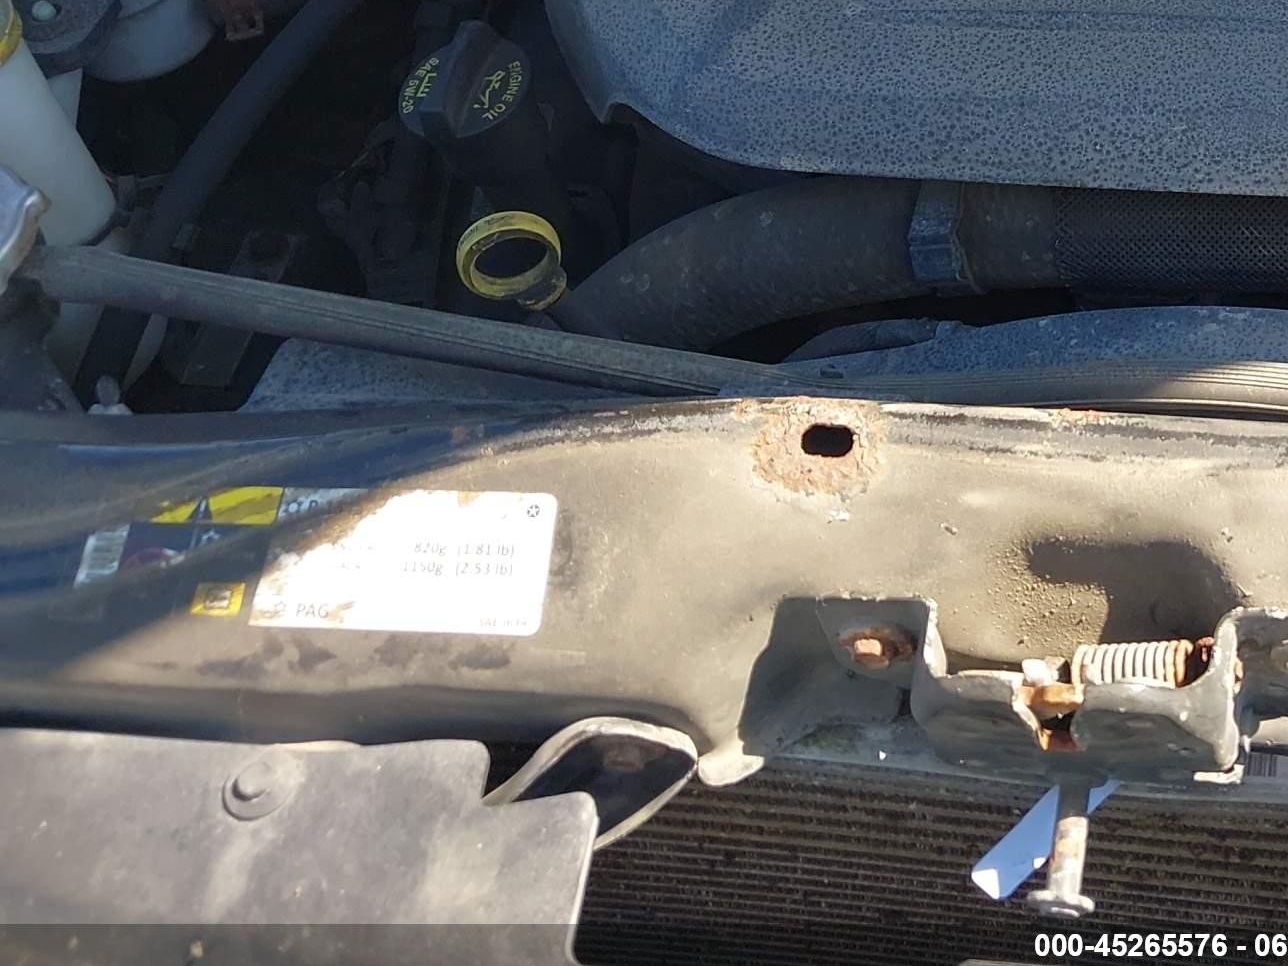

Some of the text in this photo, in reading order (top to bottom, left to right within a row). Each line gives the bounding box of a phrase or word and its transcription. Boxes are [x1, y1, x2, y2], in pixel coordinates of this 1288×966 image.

[402, 57, 440, 114] SAE 5W-20
[482, 61, 522, 120] ENGINE OIL
[414, 541, 446, 557] 820g
[402, 562, 443, 576] 1150g
[495, 564, 513, 577] lb)
[296, 602, 329, 618] PAG
